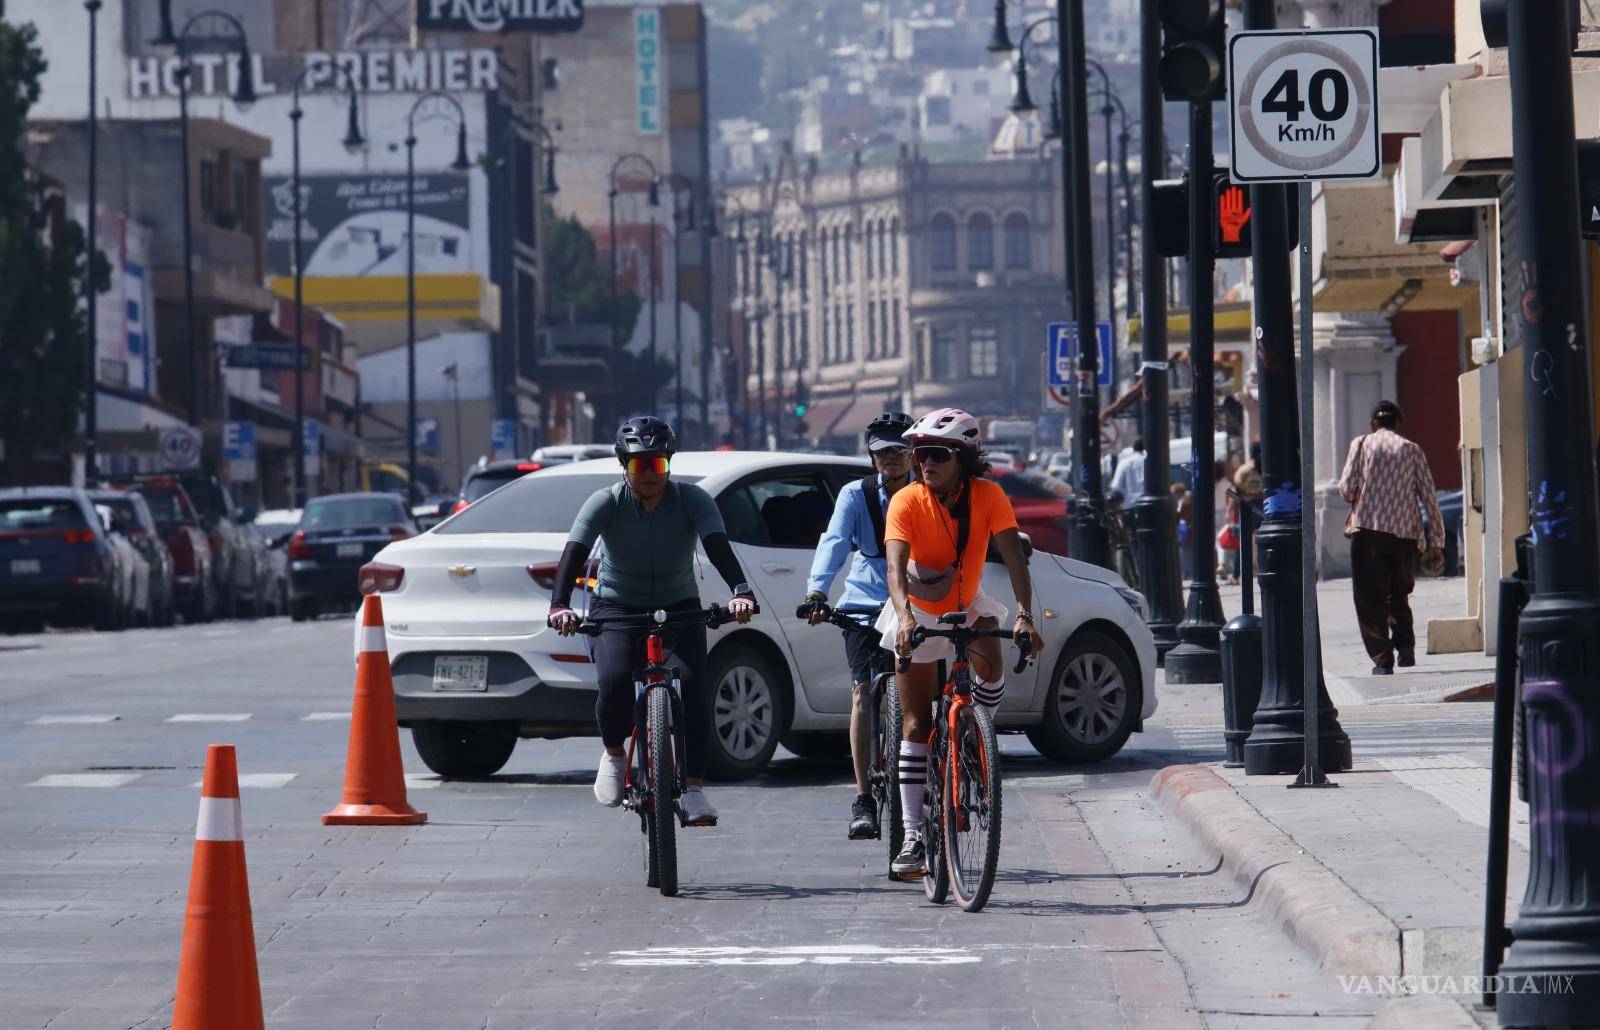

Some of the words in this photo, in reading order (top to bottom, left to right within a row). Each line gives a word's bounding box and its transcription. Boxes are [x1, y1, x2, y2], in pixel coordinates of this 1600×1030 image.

[304, 49, 498, 90] PREMIER
[636, 12, 657, 131] HOTEL
[1261, 68, 1349, 122] 40
[1278, 123, 1335, 142] Km/h
[167, 437, 192, 450] 40
